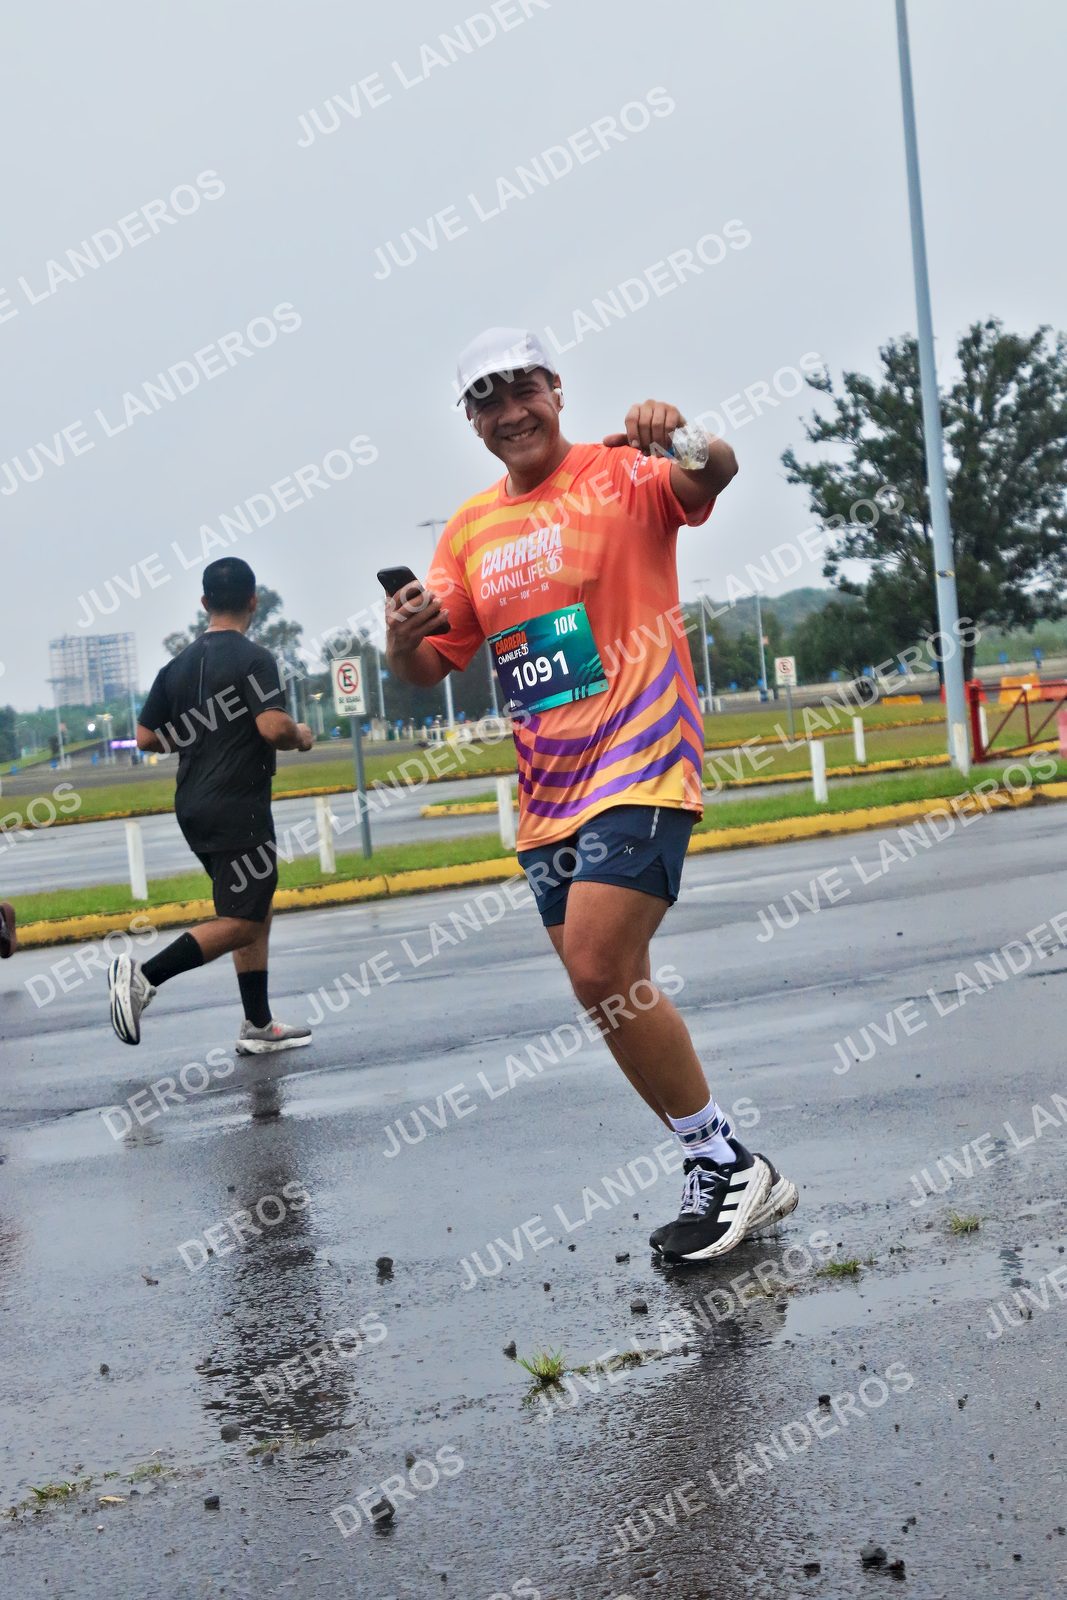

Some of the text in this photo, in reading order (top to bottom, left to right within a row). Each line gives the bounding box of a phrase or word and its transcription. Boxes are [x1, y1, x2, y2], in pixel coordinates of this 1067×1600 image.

[481, 523, 562, 579] CARRERA
[480, 560, 546, 600] OMNILIFE
[495, 631, 527, 655] CARRERA
[554, 612, 578, 636] 10K
[512, 650, 569, 690] 1091
